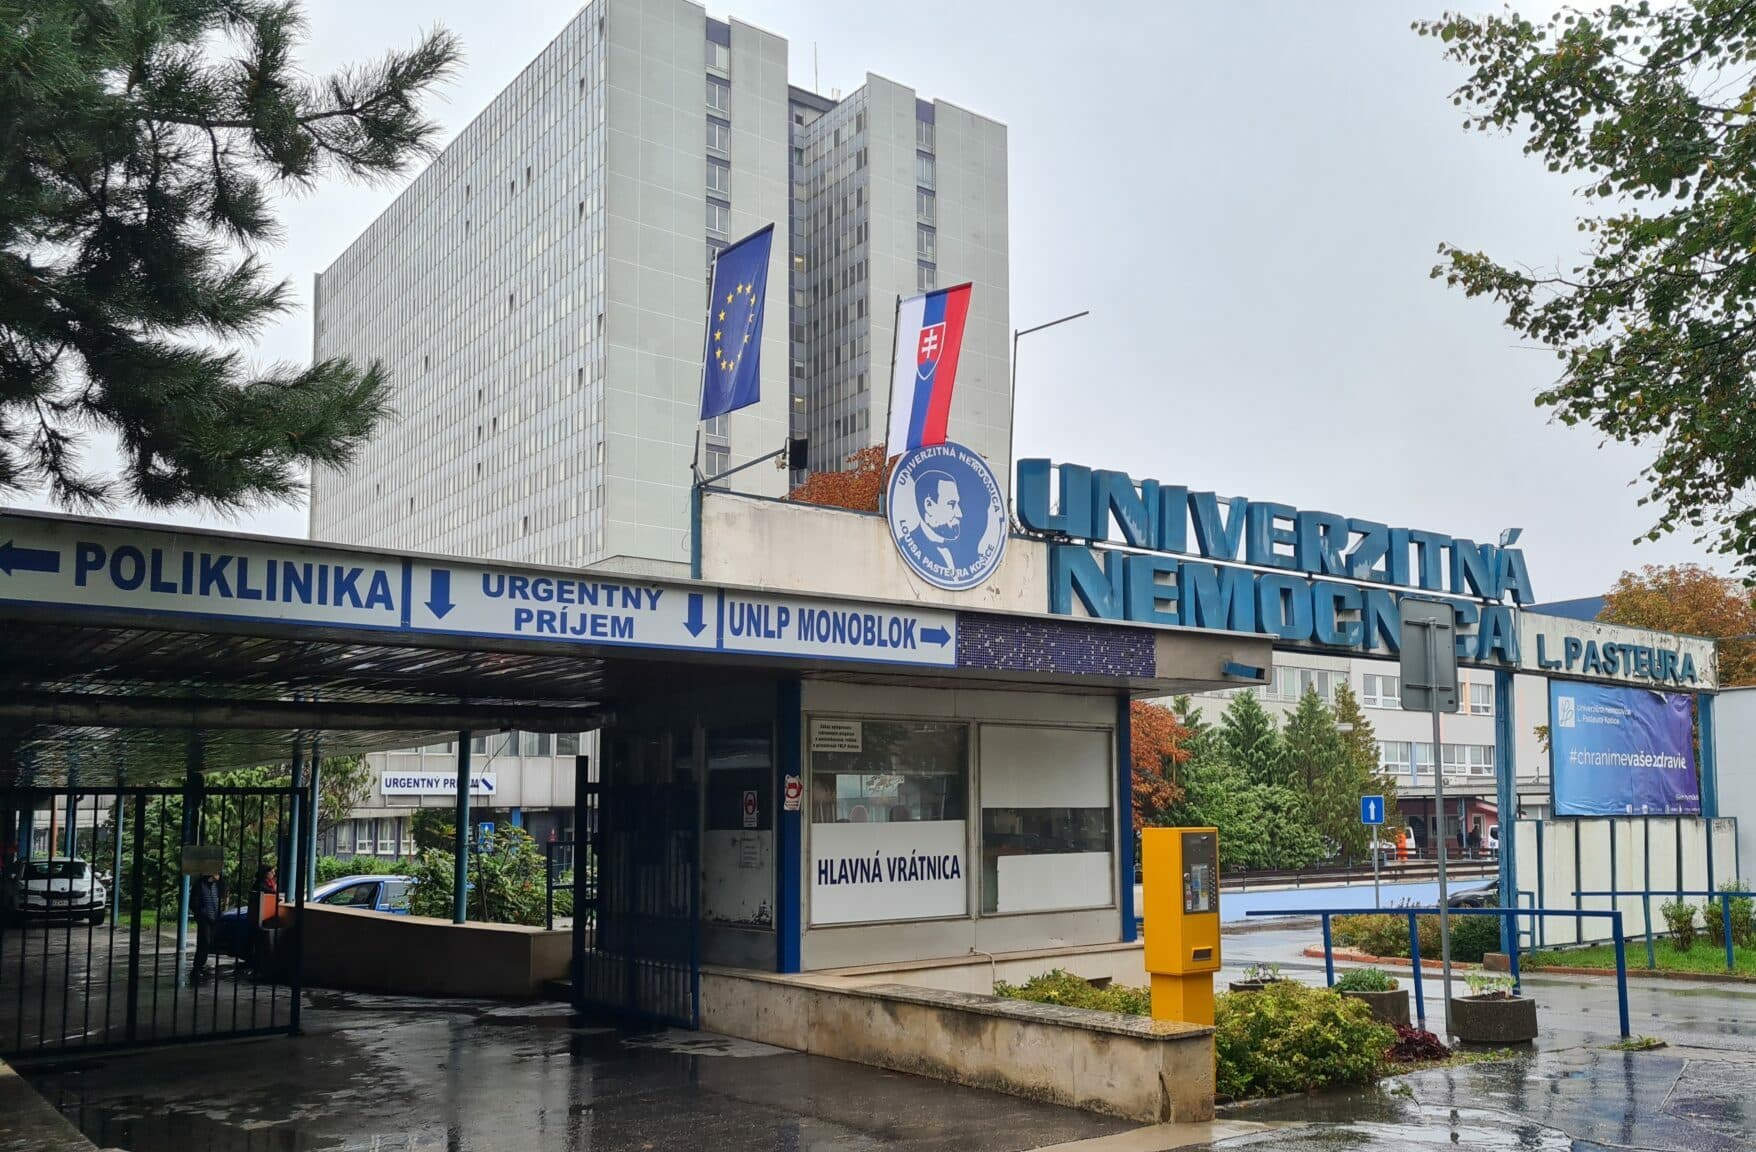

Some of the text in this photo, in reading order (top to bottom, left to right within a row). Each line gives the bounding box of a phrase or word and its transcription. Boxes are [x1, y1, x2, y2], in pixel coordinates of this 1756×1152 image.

[899, 446, 956, 486] UNIVERZITNÁ
[900, 520, 923, 560] LOUISA
[1017, 458, 1535, 604] UNIVERZITNÁ
[75, 541, 394, 610] POLIKLINIKA
[482, 573, 664, 611] URGENTNÝ
[514, 606, 634, 639] PRÍJEM
[729, 601, 917, 650] UNLP MONOBLOK
[818, 849, 960, 885] HLAVNÁ VRÁTNICA
